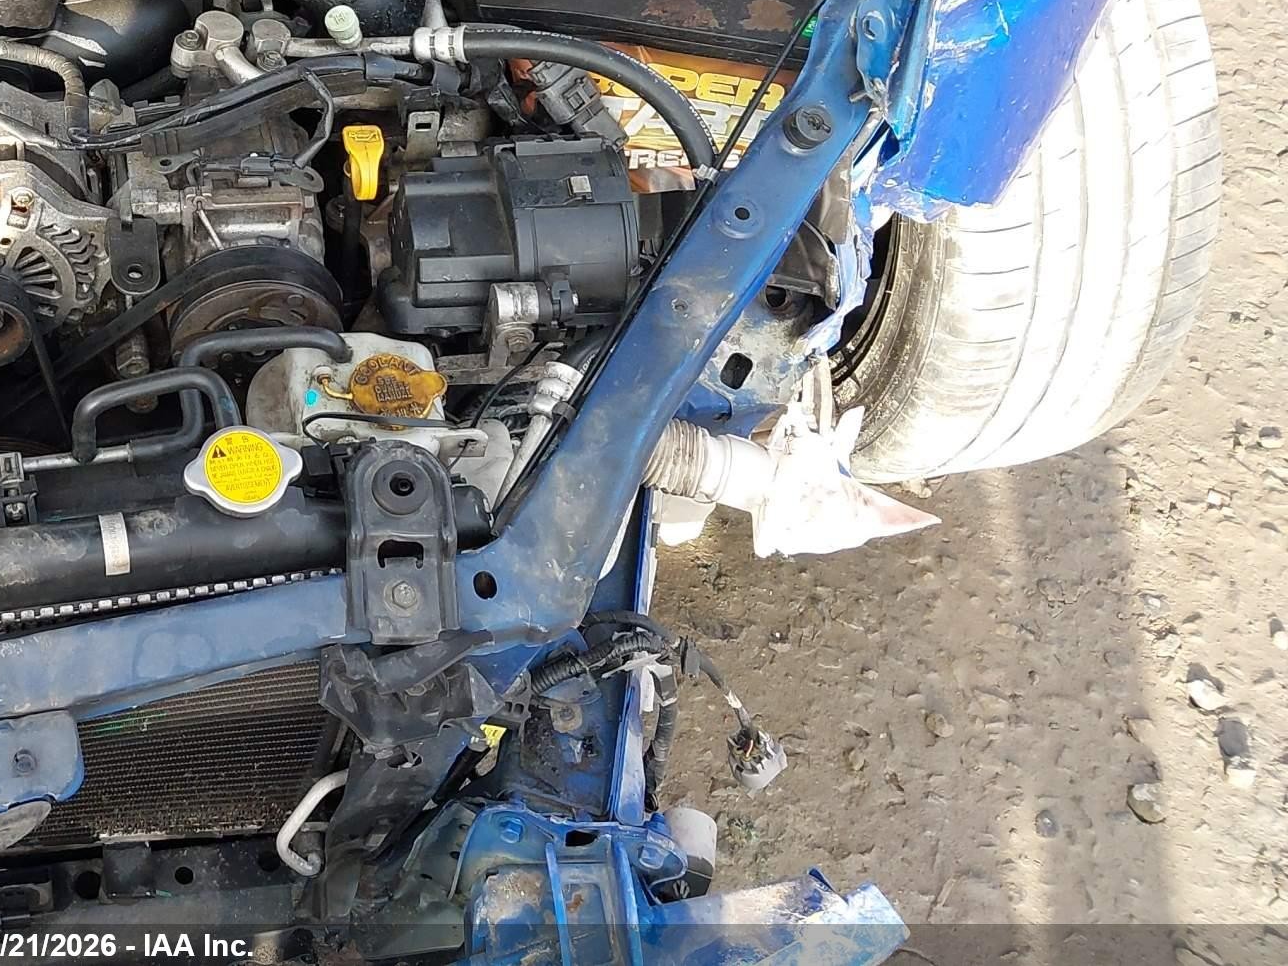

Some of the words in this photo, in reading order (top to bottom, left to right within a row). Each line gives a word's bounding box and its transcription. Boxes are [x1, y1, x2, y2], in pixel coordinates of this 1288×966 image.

[354, 355, 422, 386] COOLANT
[376, 392, 413, 403] MANUAL
[226, 442, 264, 455] WARNING
